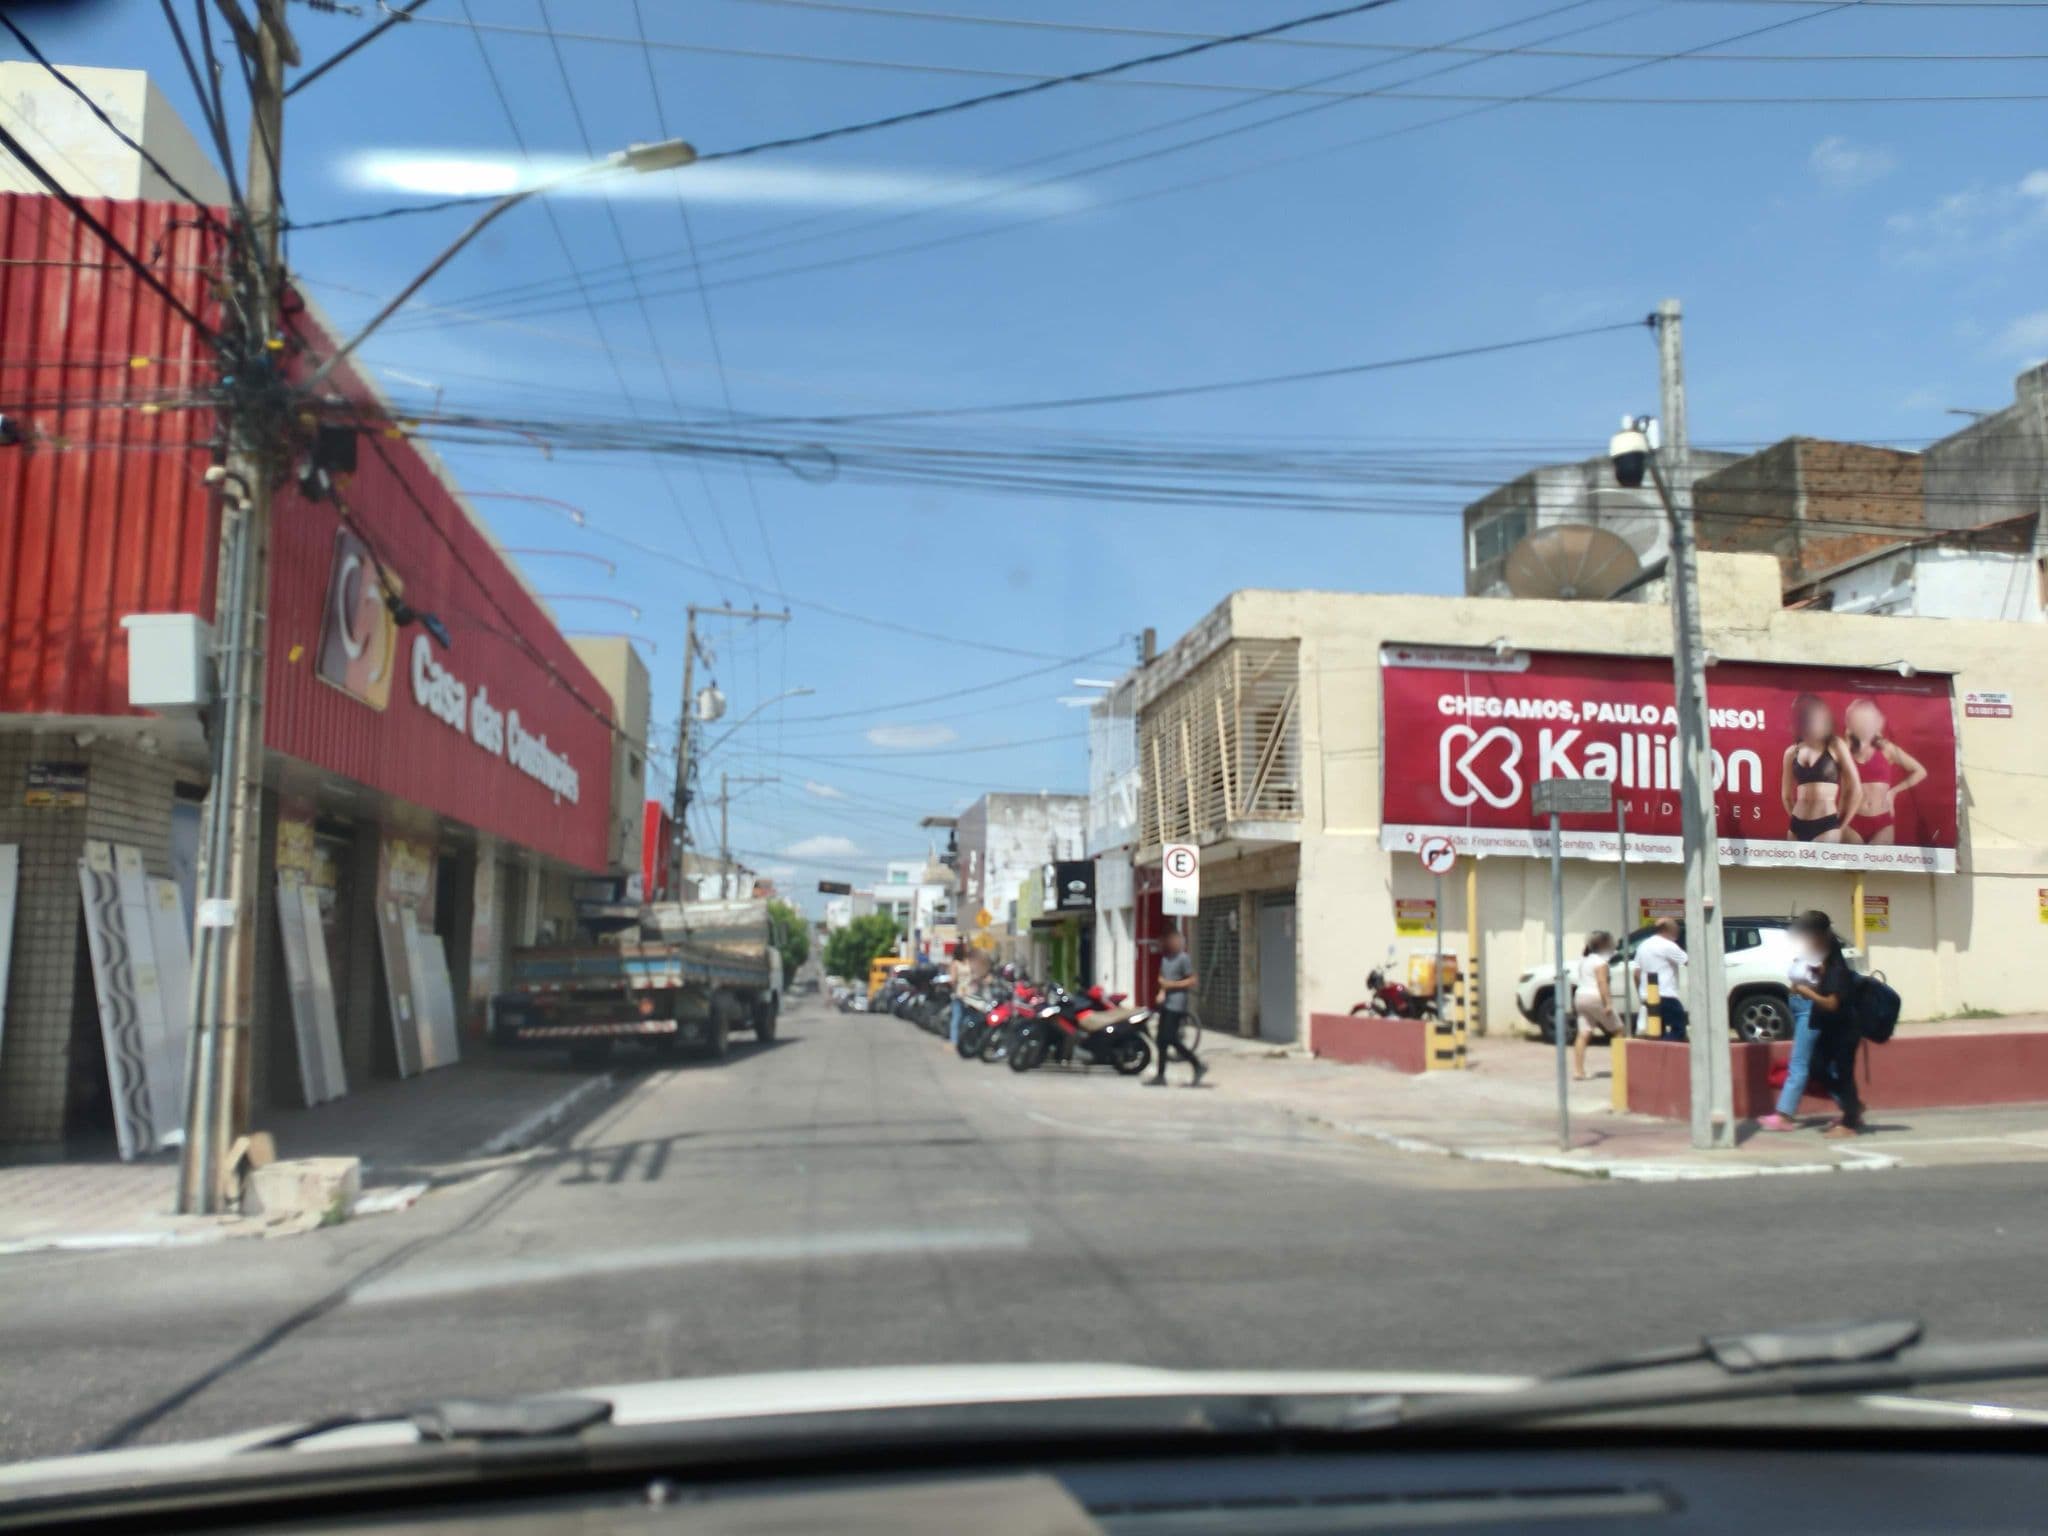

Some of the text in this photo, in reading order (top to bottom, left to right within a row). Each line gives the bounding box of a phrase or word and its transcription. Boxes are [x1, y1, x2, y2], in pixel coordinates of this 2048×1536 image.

[412, 634, 466, 733] Casa
[1438, 695, 1766, 730] CHEGAMOS, PAULO ANSO!
[1175, 853, 1186, 872] E
